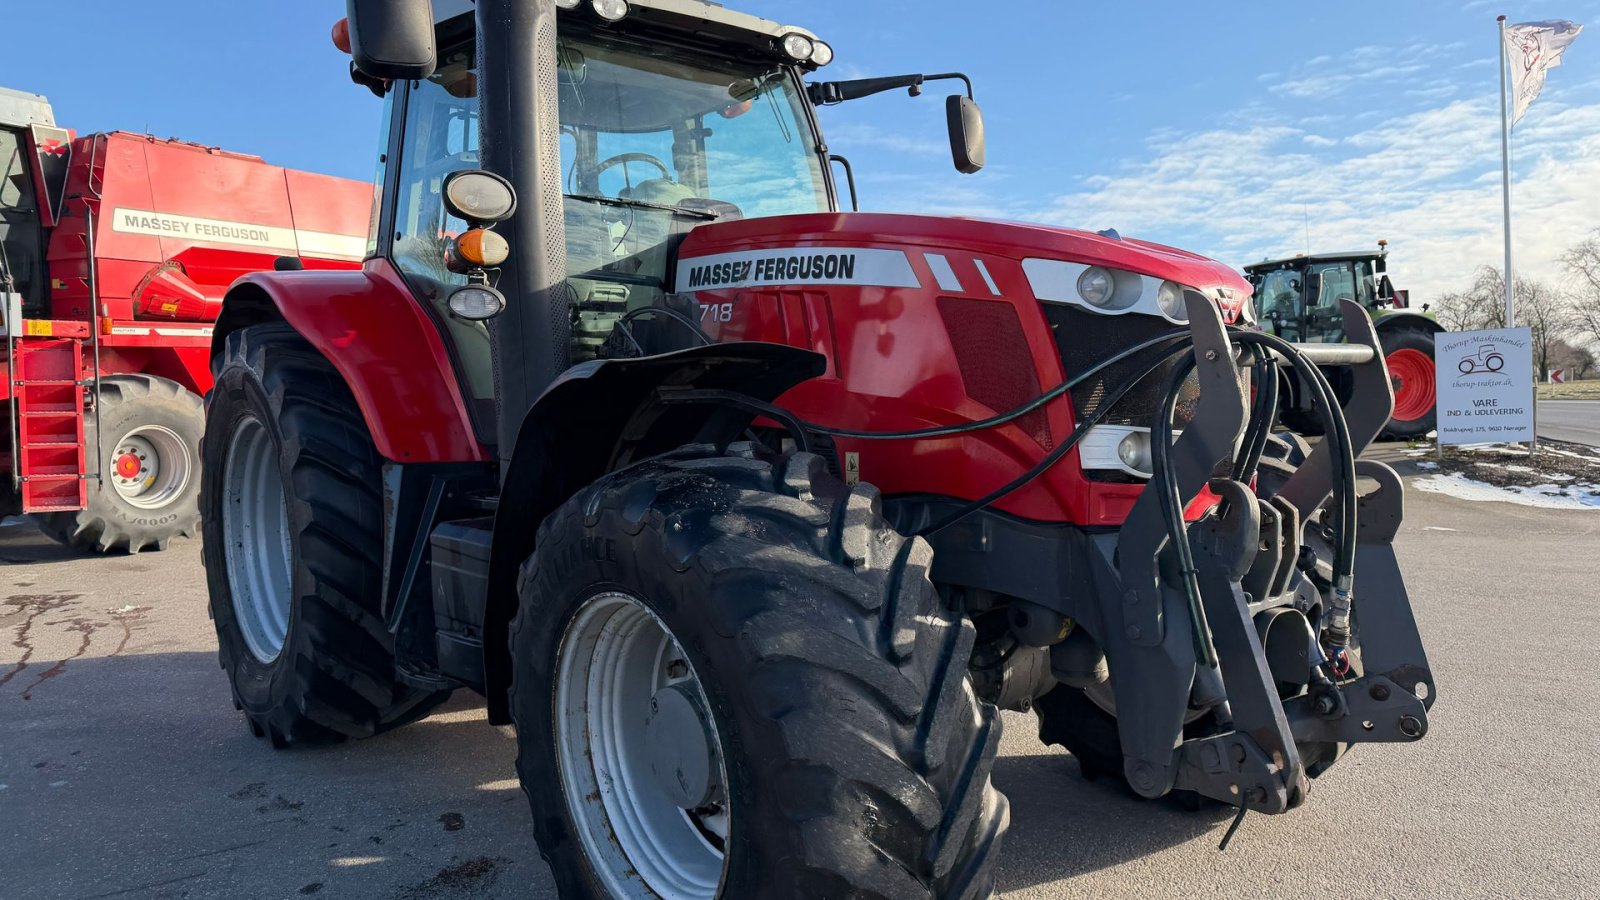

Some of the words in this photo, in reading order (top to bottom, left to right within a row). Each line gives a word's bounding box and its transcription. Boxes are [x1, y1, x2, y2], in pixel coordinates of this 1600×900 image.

[124, 214, 190, 234] MASSEY
[194, 223, 269, 242] FERGUSON
[689, 260, 752, 288] MASSEY
[754, 254, 855, 281] FERGUSON
[700, 303, 733, 323] 718
[1442, 339, 1469, 353] Thorup
[1470, 334, 1527, 348] Maskinhandel
[1452, 378, 1514, 389] thorup-traktor.dk
[1472, 398, 1498, 407] VARE
[1474, 407, 1524, 416] UDLEVERING
